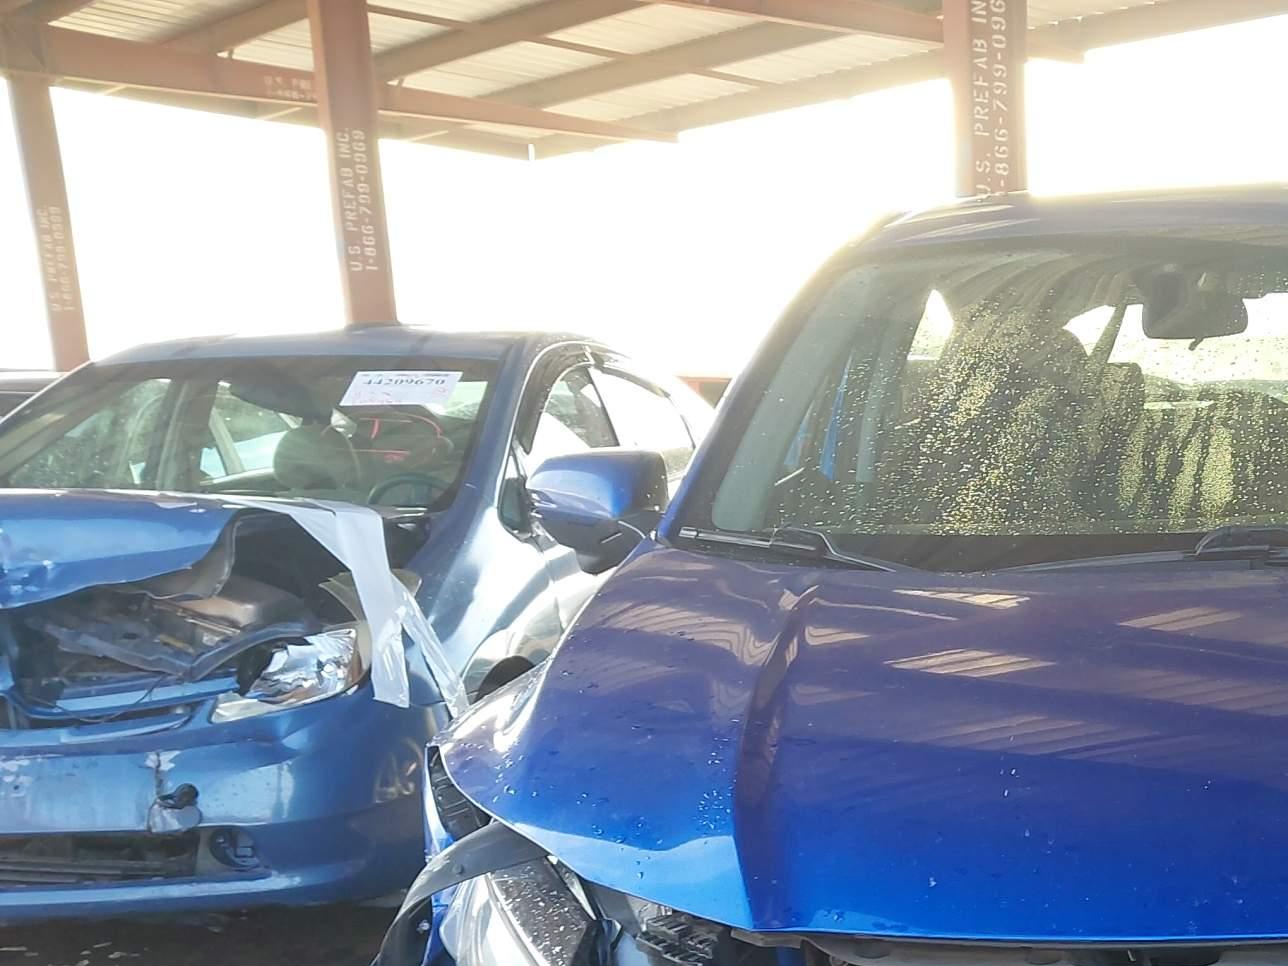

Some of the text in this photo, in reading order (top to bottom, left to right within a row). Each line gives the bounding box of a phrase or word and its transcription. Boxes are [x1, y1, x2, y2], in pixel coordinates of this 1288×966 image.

[972, 39, 990, 136] PREFAB
[337, 127, 351, 158] INC.
[340, 167, 358, 231] PREFAB
